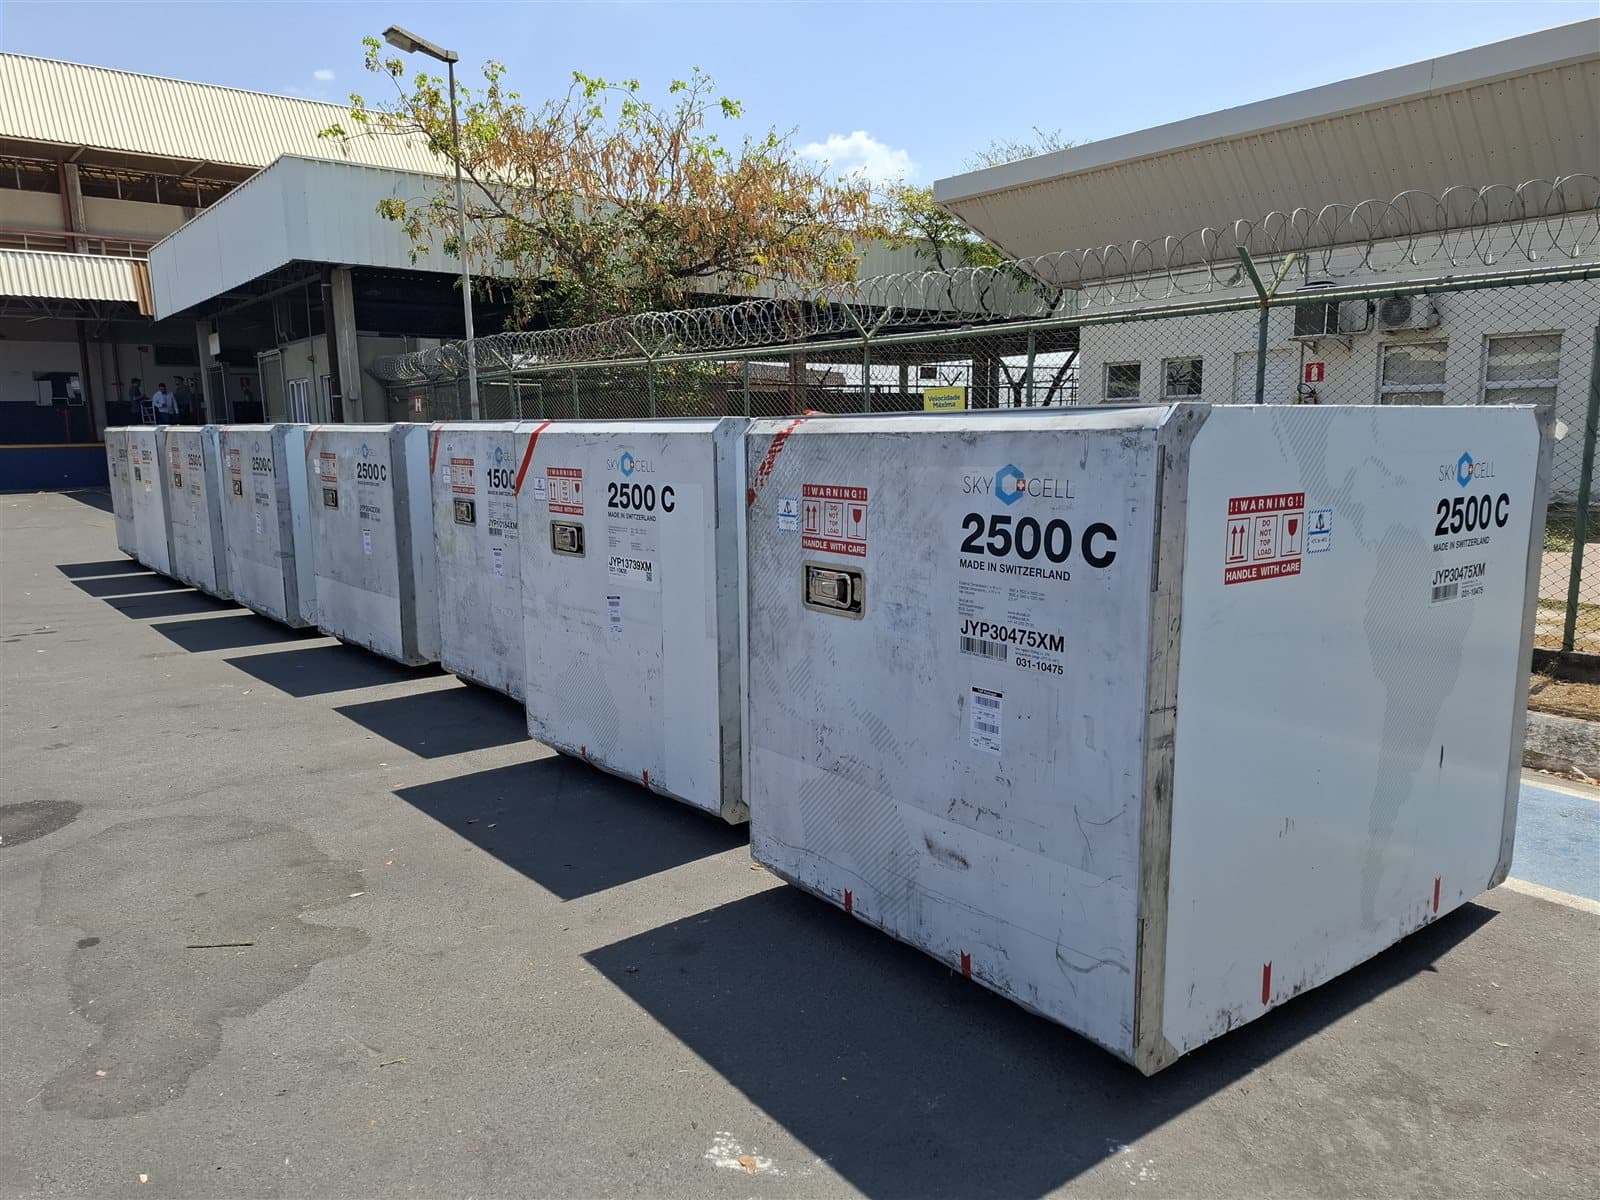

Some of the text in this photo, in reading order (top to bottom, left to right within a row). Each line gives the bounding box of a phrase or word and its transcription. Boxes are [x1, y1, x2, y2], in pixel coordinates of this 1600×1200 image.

[252, 456, 267, 472] 2500
[356, 462, 387, 481] 2500 C
[962, 475, 1076, 500] SKY CELL
[607, 482, 676, 513] 2500 C
[1229, 496, 1304, 513] !!WARNING!!
[1262, 519, 1271, 527] DO
[1434, 493, 1510, 537] 2500 C
[960, 512, 1118, 569] 2500 C
[1259, 529, 1272, 537] NOT
[1260, 538, 1271, 546] TOP
[803, 539, 866, 554] HANDLE WITH CARE
[1257, 548, 1272, 557] LOAD
[1433, 536, 1491, 553] MADE IN SWITZERLAND
[608, 556, 653, 572] JYP13739XM
[959, 559, 1072, 582] MADE IN SWITZERLAND
[1226, 562, 1301, 581] HANDLE WITH CARE
[1432, 563, 1486, 586] JYP30475XM
[960, 619, 1065, 653] JYP30475XM
[1016, 657, 1065, 676] 031-10475
